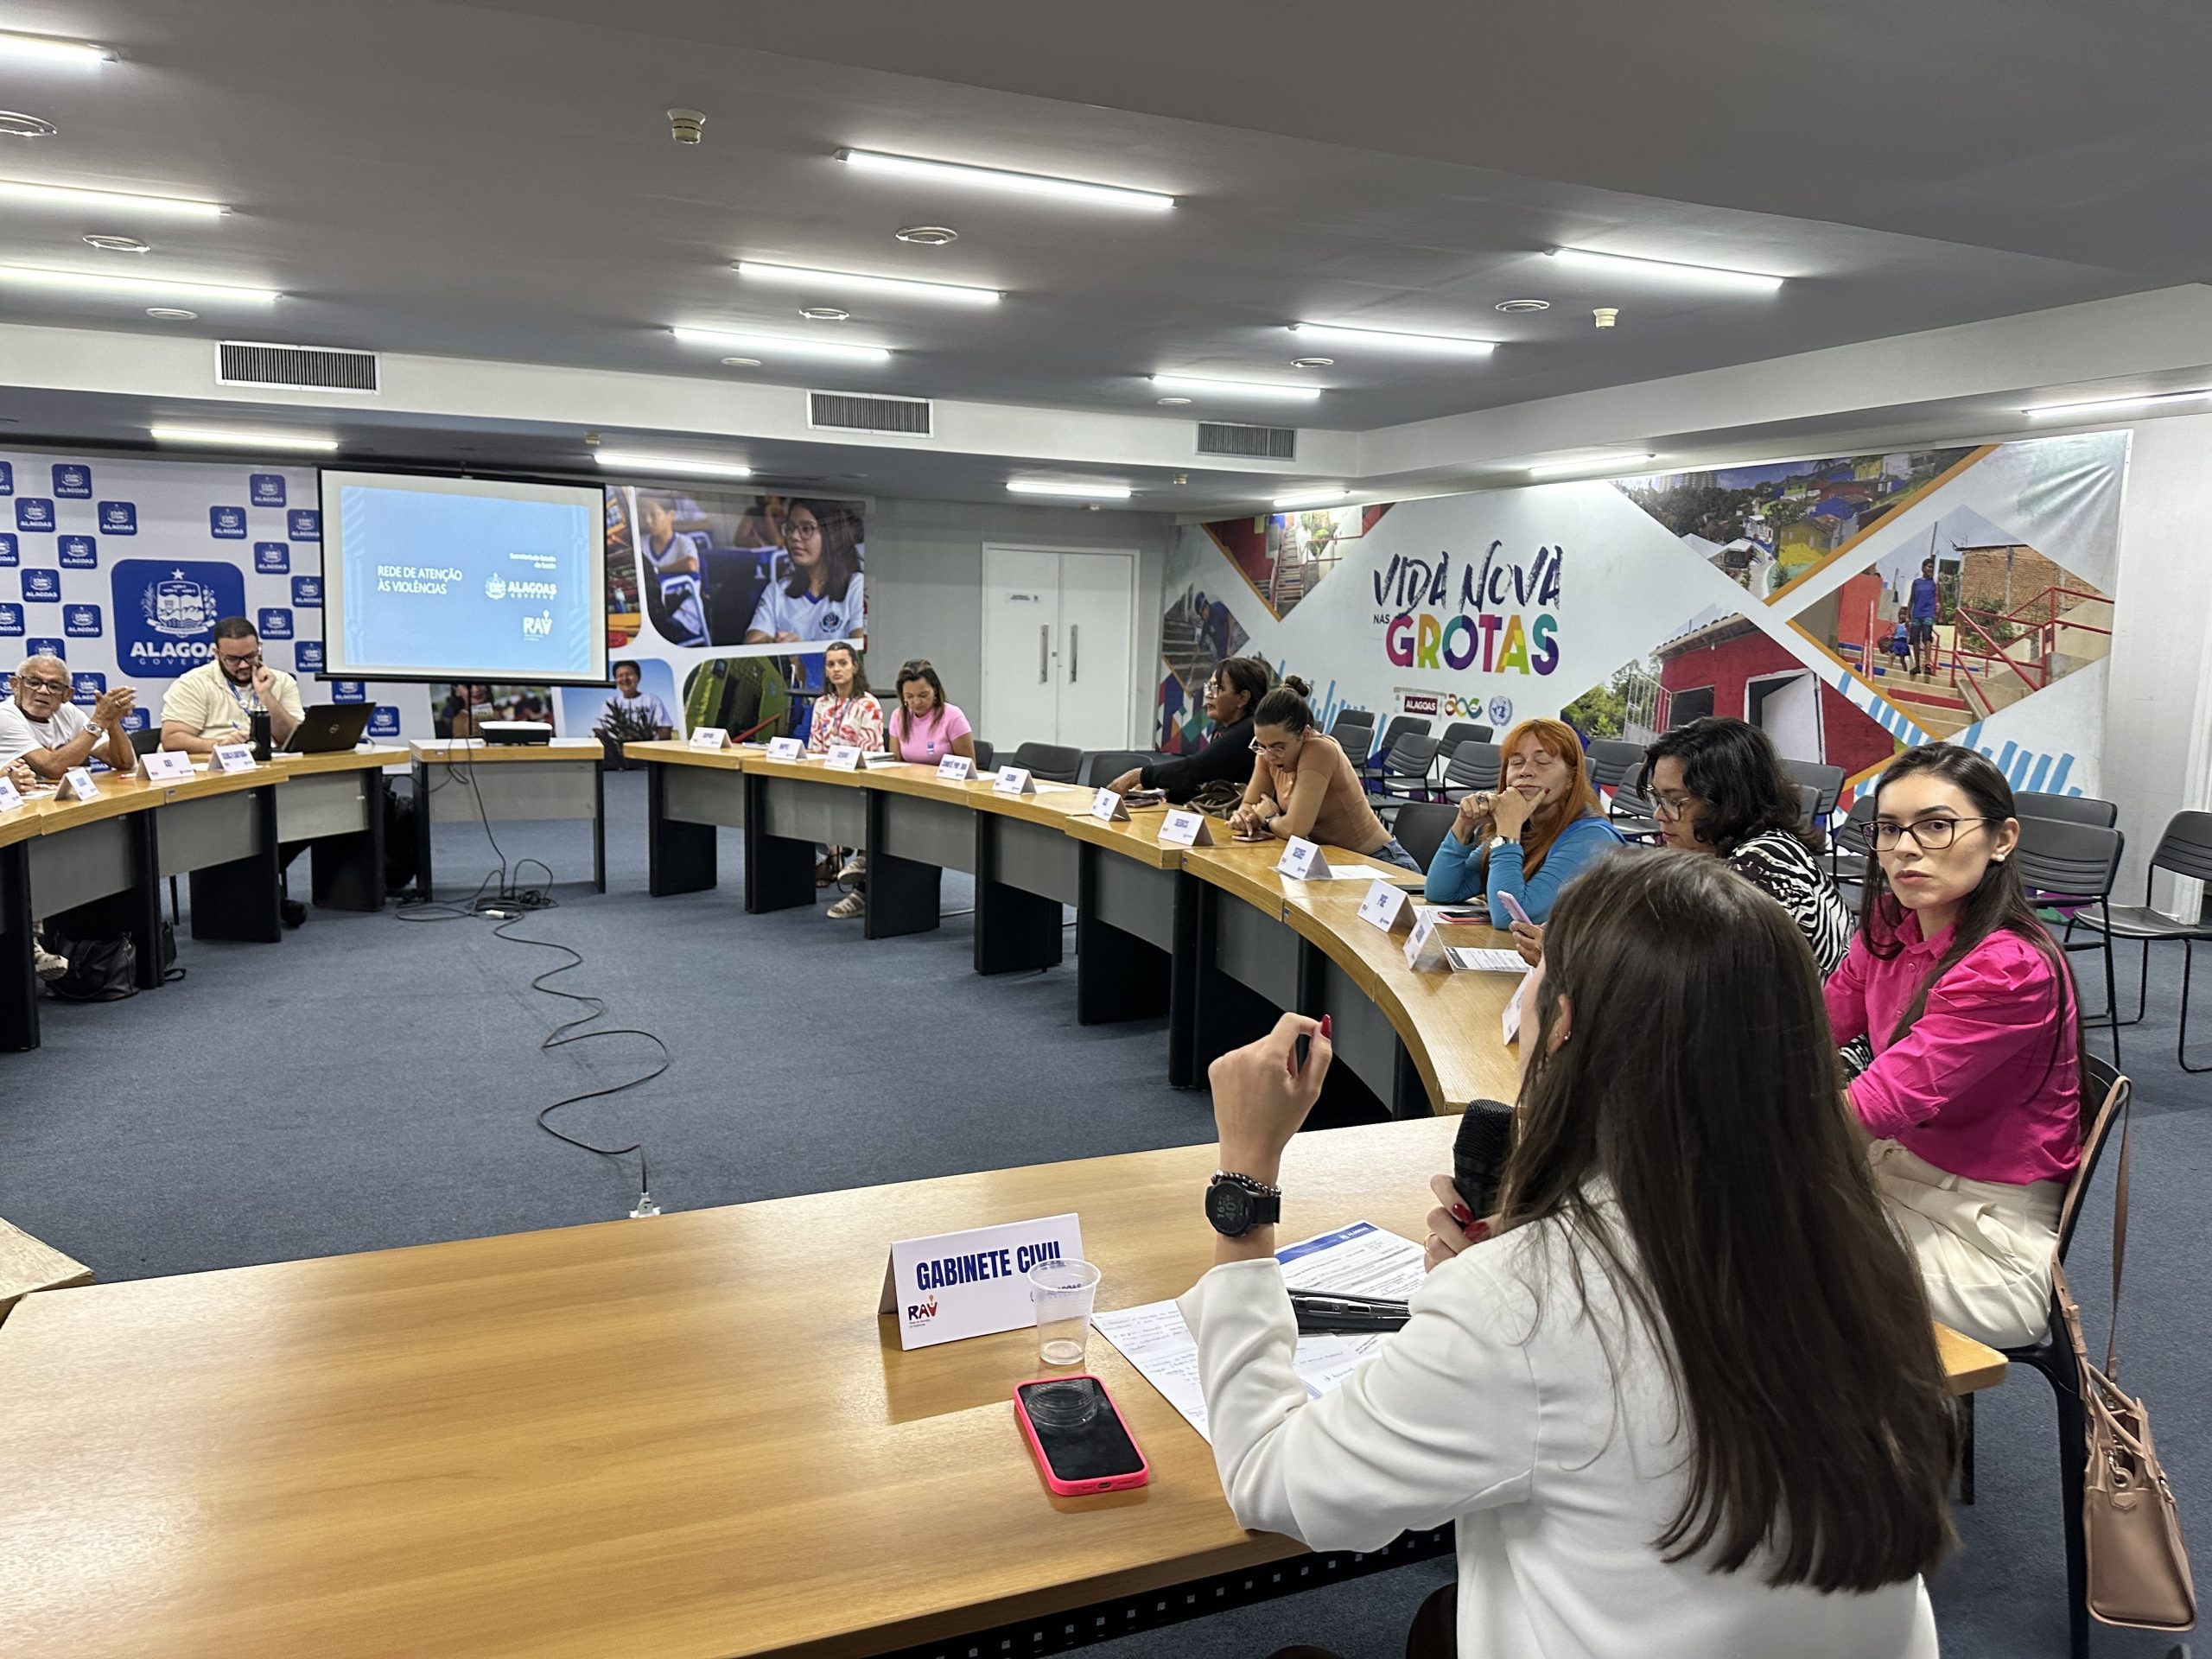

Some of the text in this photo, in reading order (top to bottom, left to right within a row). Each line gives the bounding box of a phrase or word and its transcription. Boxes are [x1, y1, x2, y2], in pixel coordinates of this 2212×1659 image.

[378, 565, 462, 582] REDE DE ATENÇÃO
[1374, 539, 1563, 620] VIDA NOVA
[391, 579, 448, 594] VIOLÊNCIAS
[507, 581, 557, 595] ALAGOAS
[524, 616, 553, 635] RAV
[1373, 614, 1390, 625] NAS
[130, 641, 217, 658] ALAGOA
[1386, 613, 1559, 676] GROTAS
[1405, 700, 1436, 711] ALAGOAS
[916, 1249, 1012, 1291] GABINETE
[908, 1301, 938, 1321] RAV
